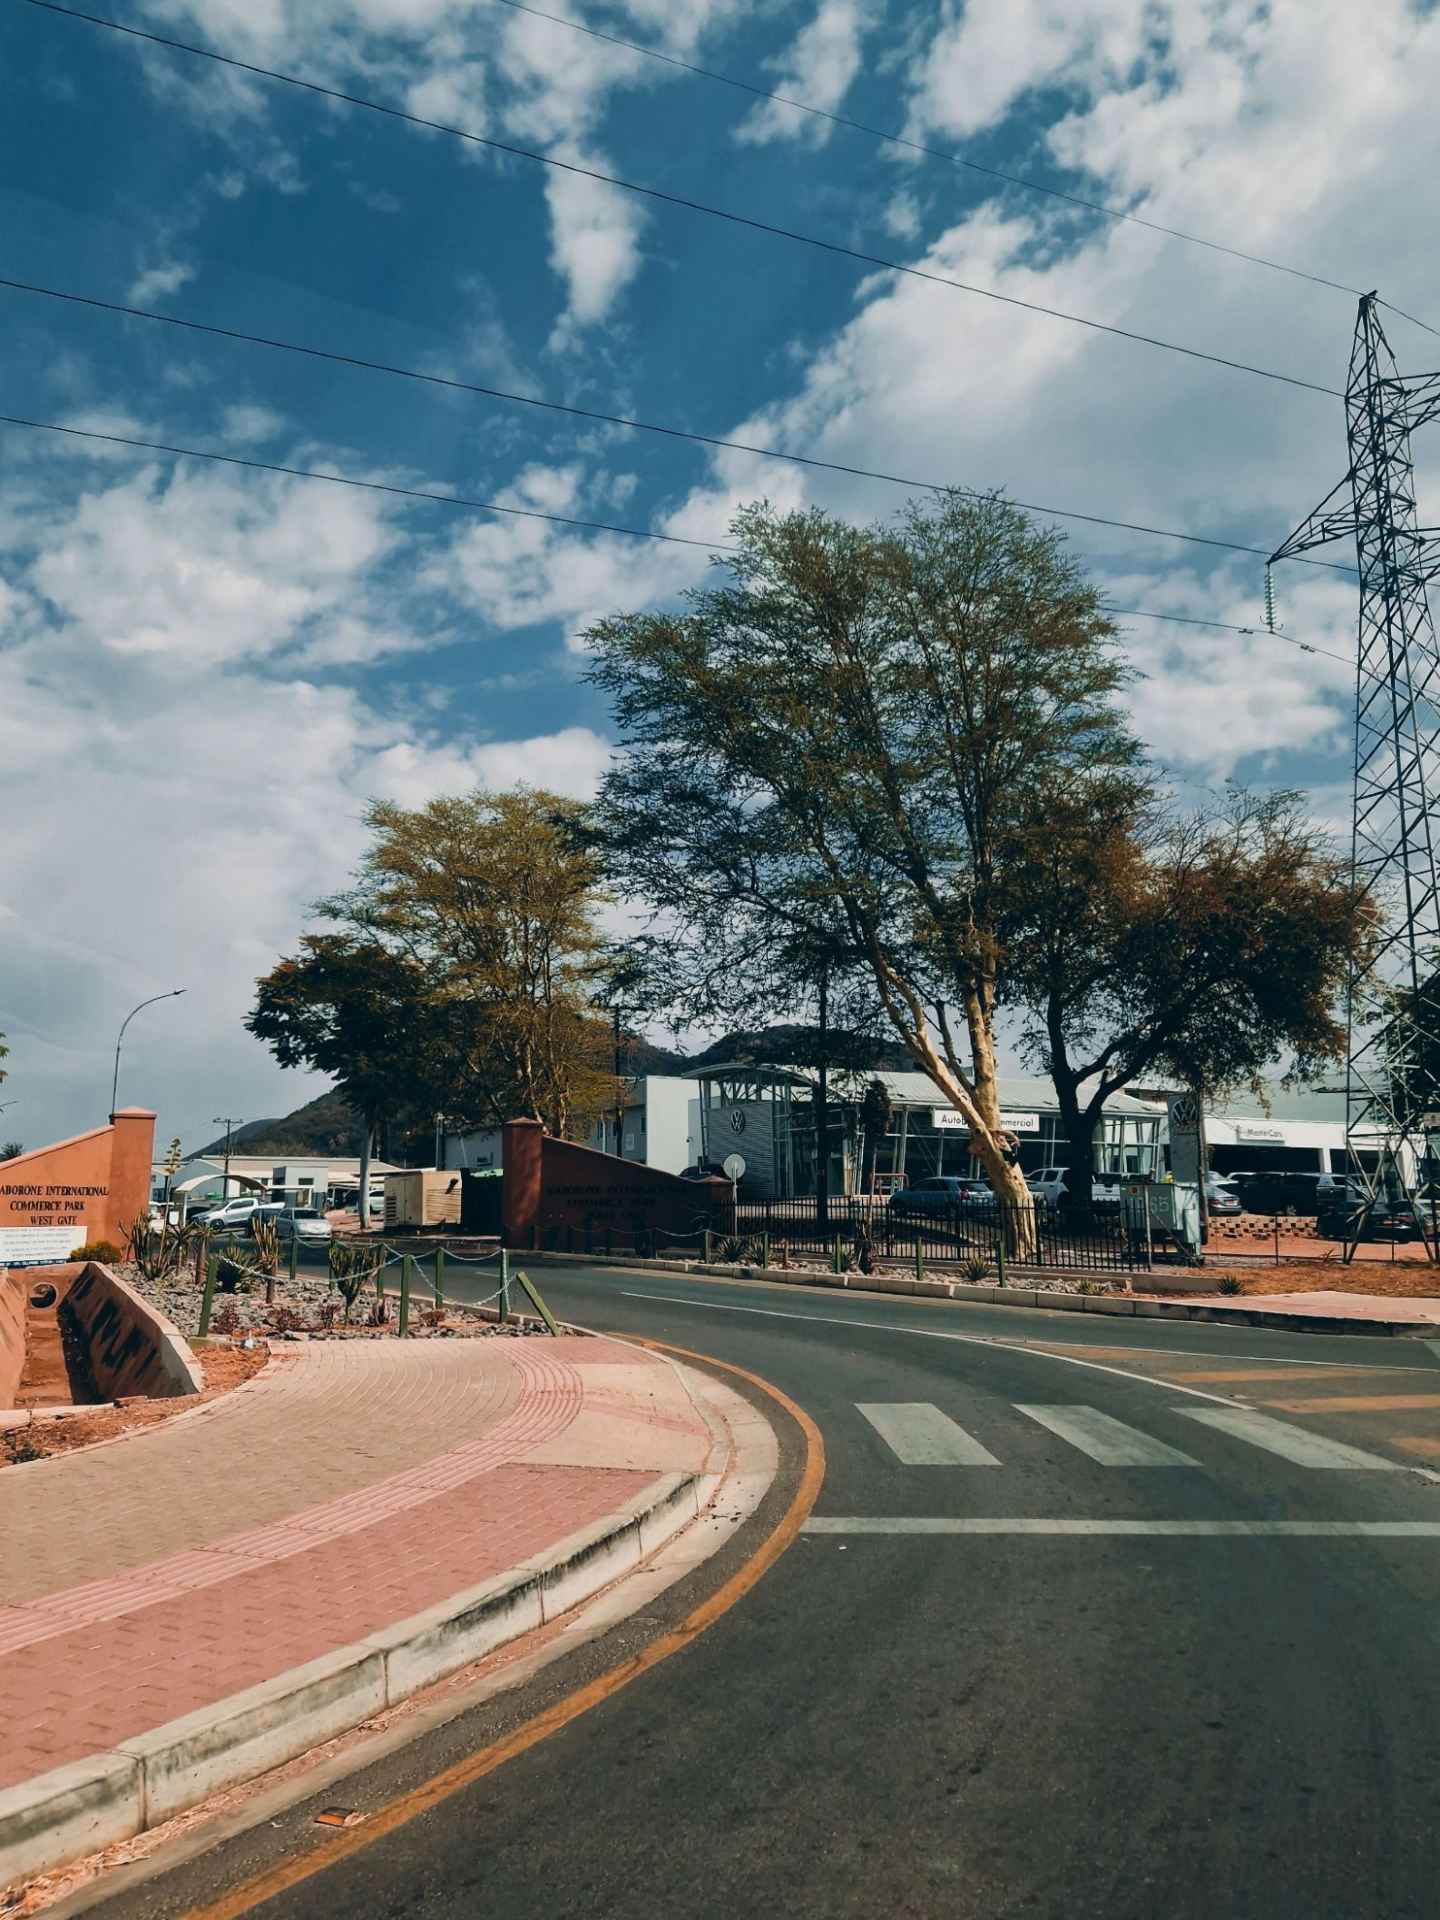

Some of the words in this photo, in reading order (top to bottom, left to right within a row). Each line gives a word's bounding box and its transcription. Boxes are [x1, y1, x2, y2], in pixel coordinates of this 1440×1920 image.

[1000, 1118, 1034, 1128] mmercial
[0, 1185, 43, 1196] ABORONE
[46, 1185, 109, 1196] INTERNATIONAL
[10, 1200, 62, 1211] COMMERCE
[64, 1201, 85, 1211] PARK
[30, 1215, 54, 1226] WEST
[57, 1215, 78, 1225] GATE
